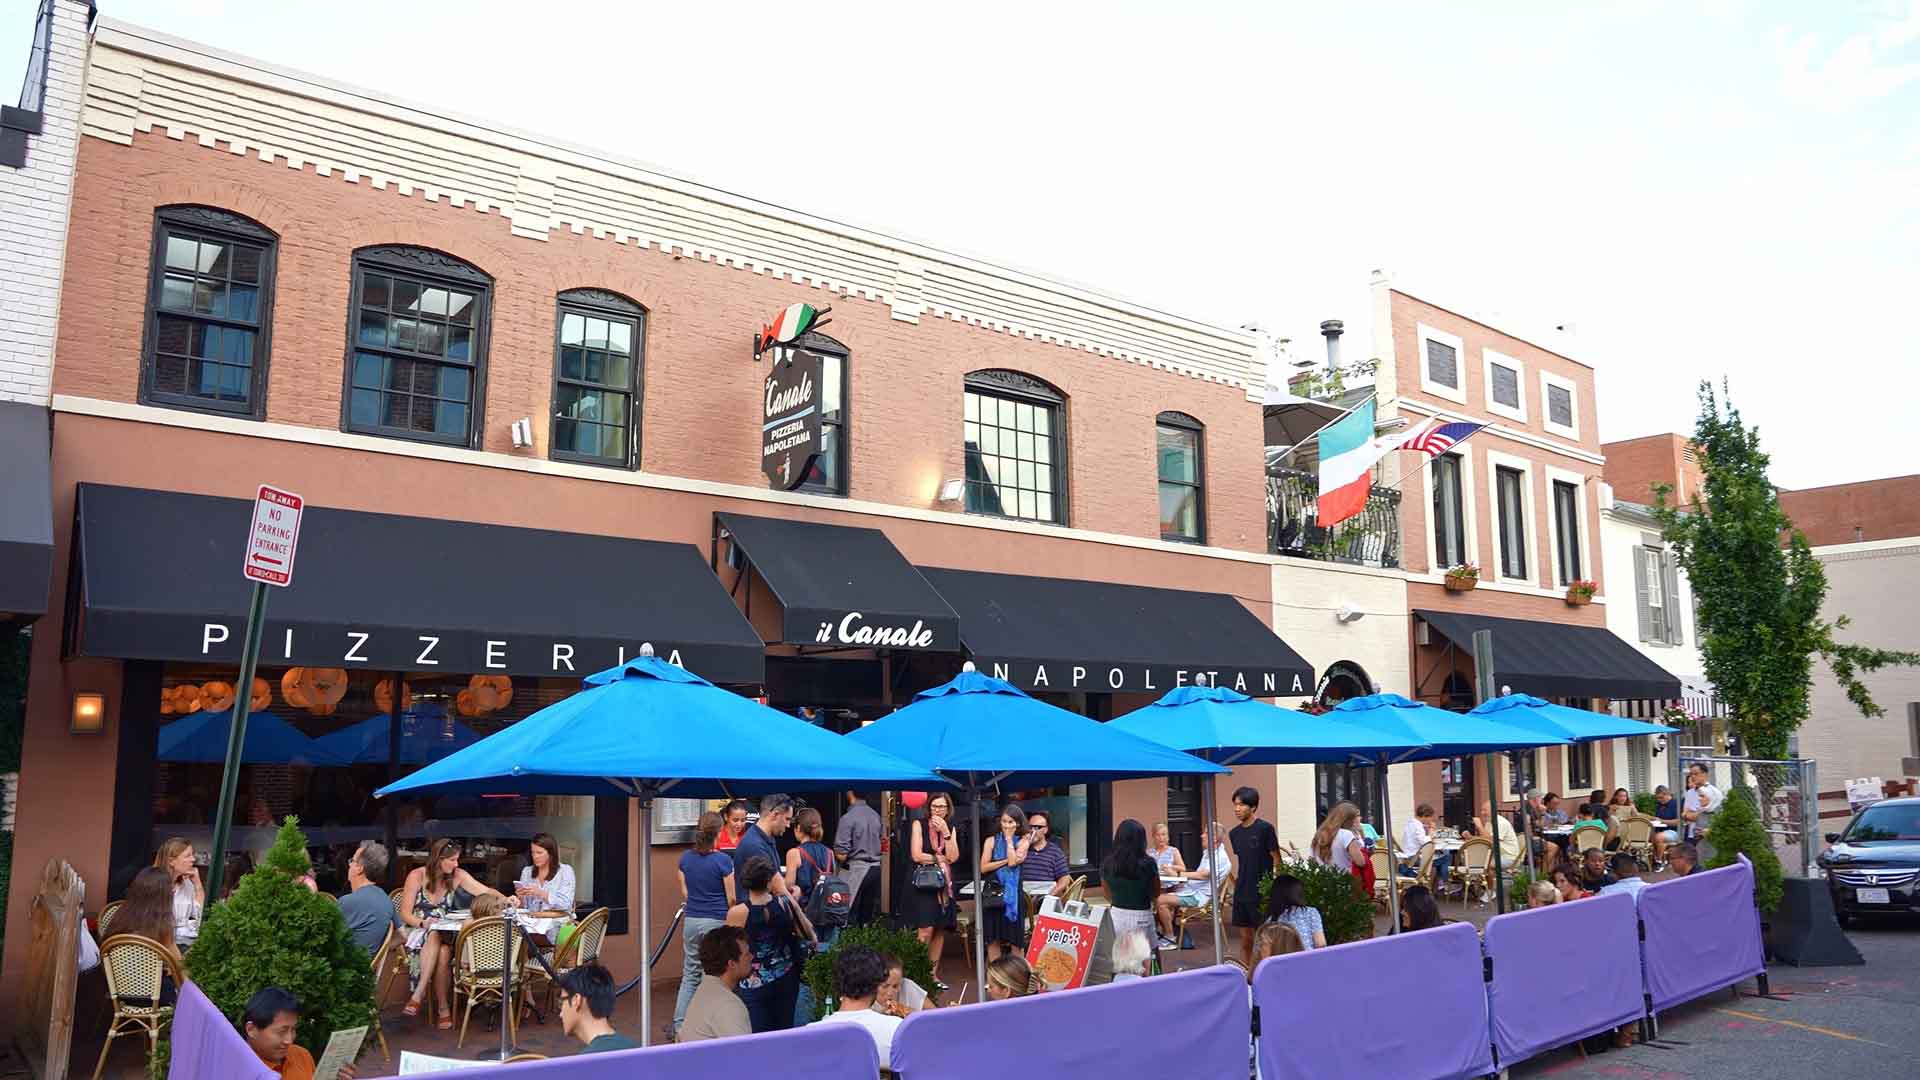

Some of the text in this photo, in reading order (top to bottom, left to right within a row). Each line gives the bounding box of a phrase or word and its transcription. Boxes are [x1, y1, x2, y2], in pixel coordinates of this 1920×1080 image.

[766, 371, 812, 417] Canale
[771, 420, 804, 441] PIZZERIA
[764, 432, 811, 456] NAPOLETANA
[268, 508, 281, 521] NO
[257, 522, 290, 540] PARKING
[255, 538, 288, 555] ENTRANCE
[815, 612, 933, 647] il Canale
[202, 623, 685, 671] PIZZERIA
[1047, 929, 1069, 945] yelp
